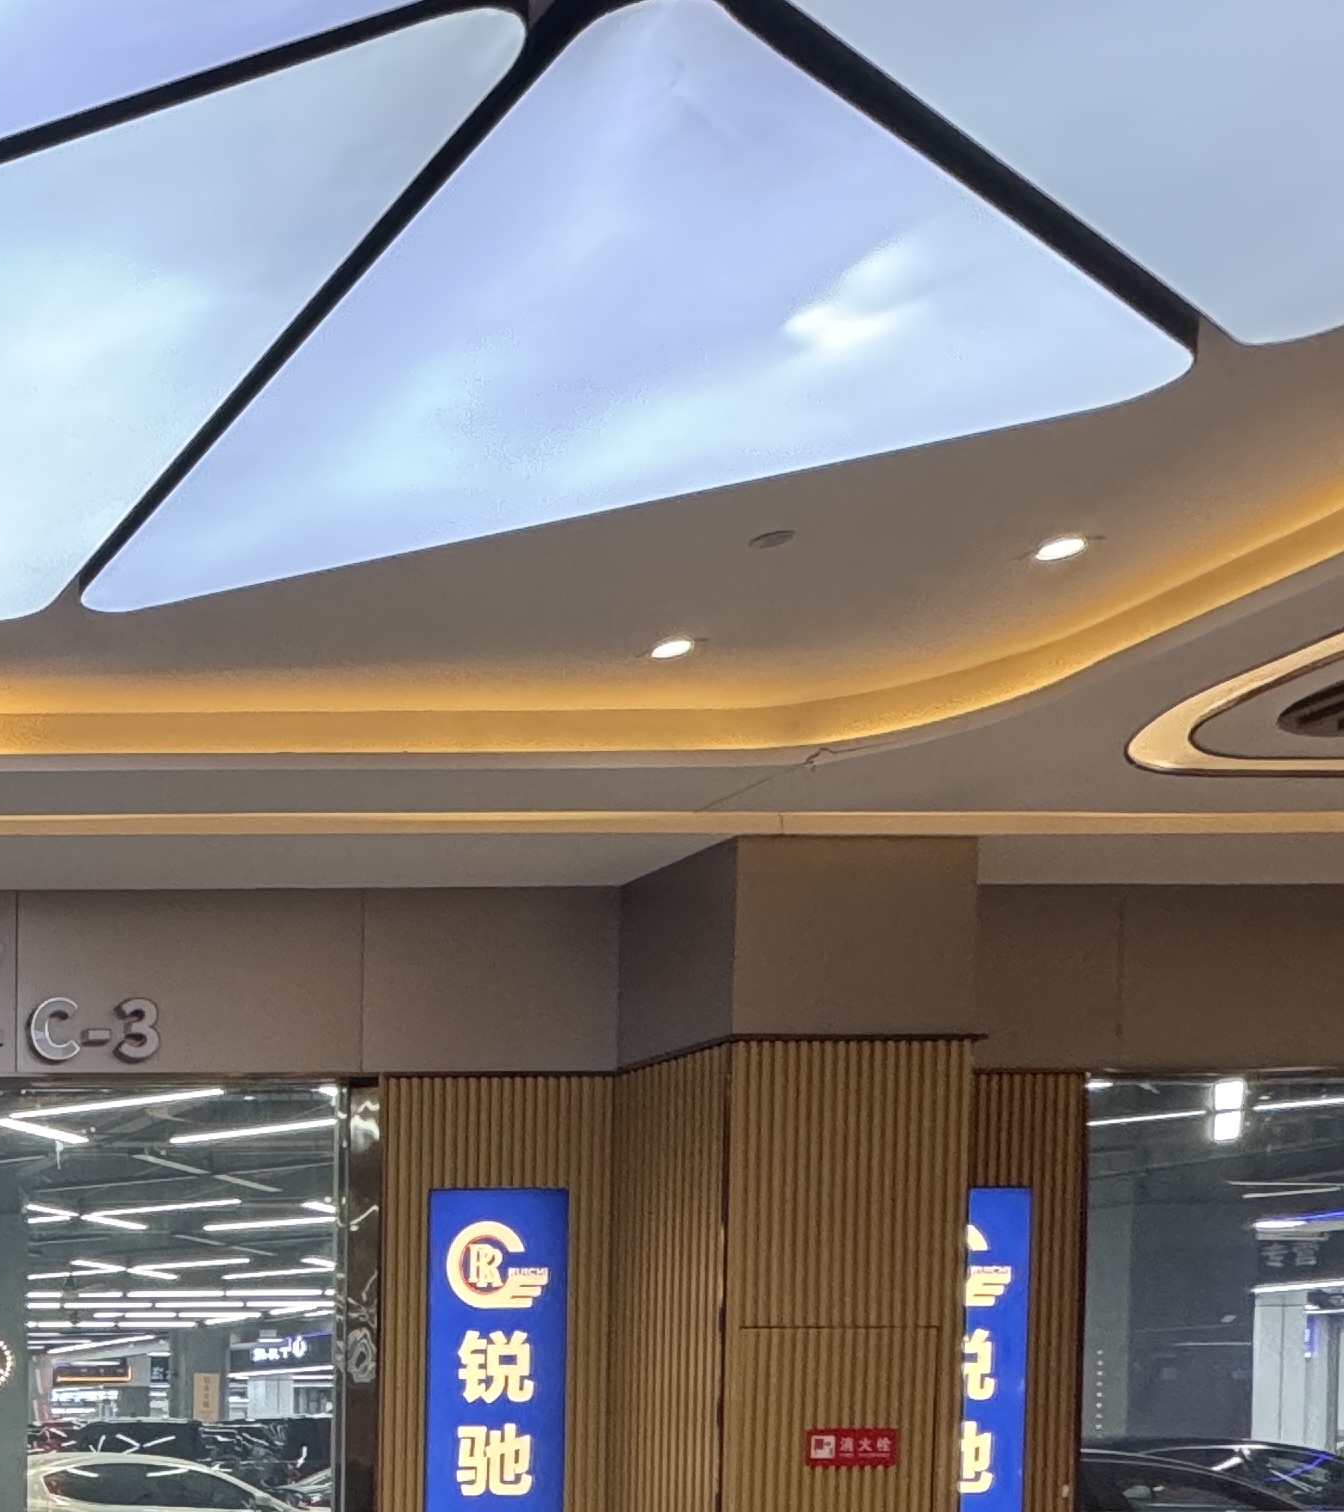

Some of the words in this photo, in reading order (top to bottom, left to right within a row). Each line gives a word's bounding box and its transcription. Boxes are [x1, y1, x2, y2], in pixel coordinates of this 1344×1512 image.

[27, 997, 160, 1063] C-3
[839, 1436, 891, 1452] 消火栓
